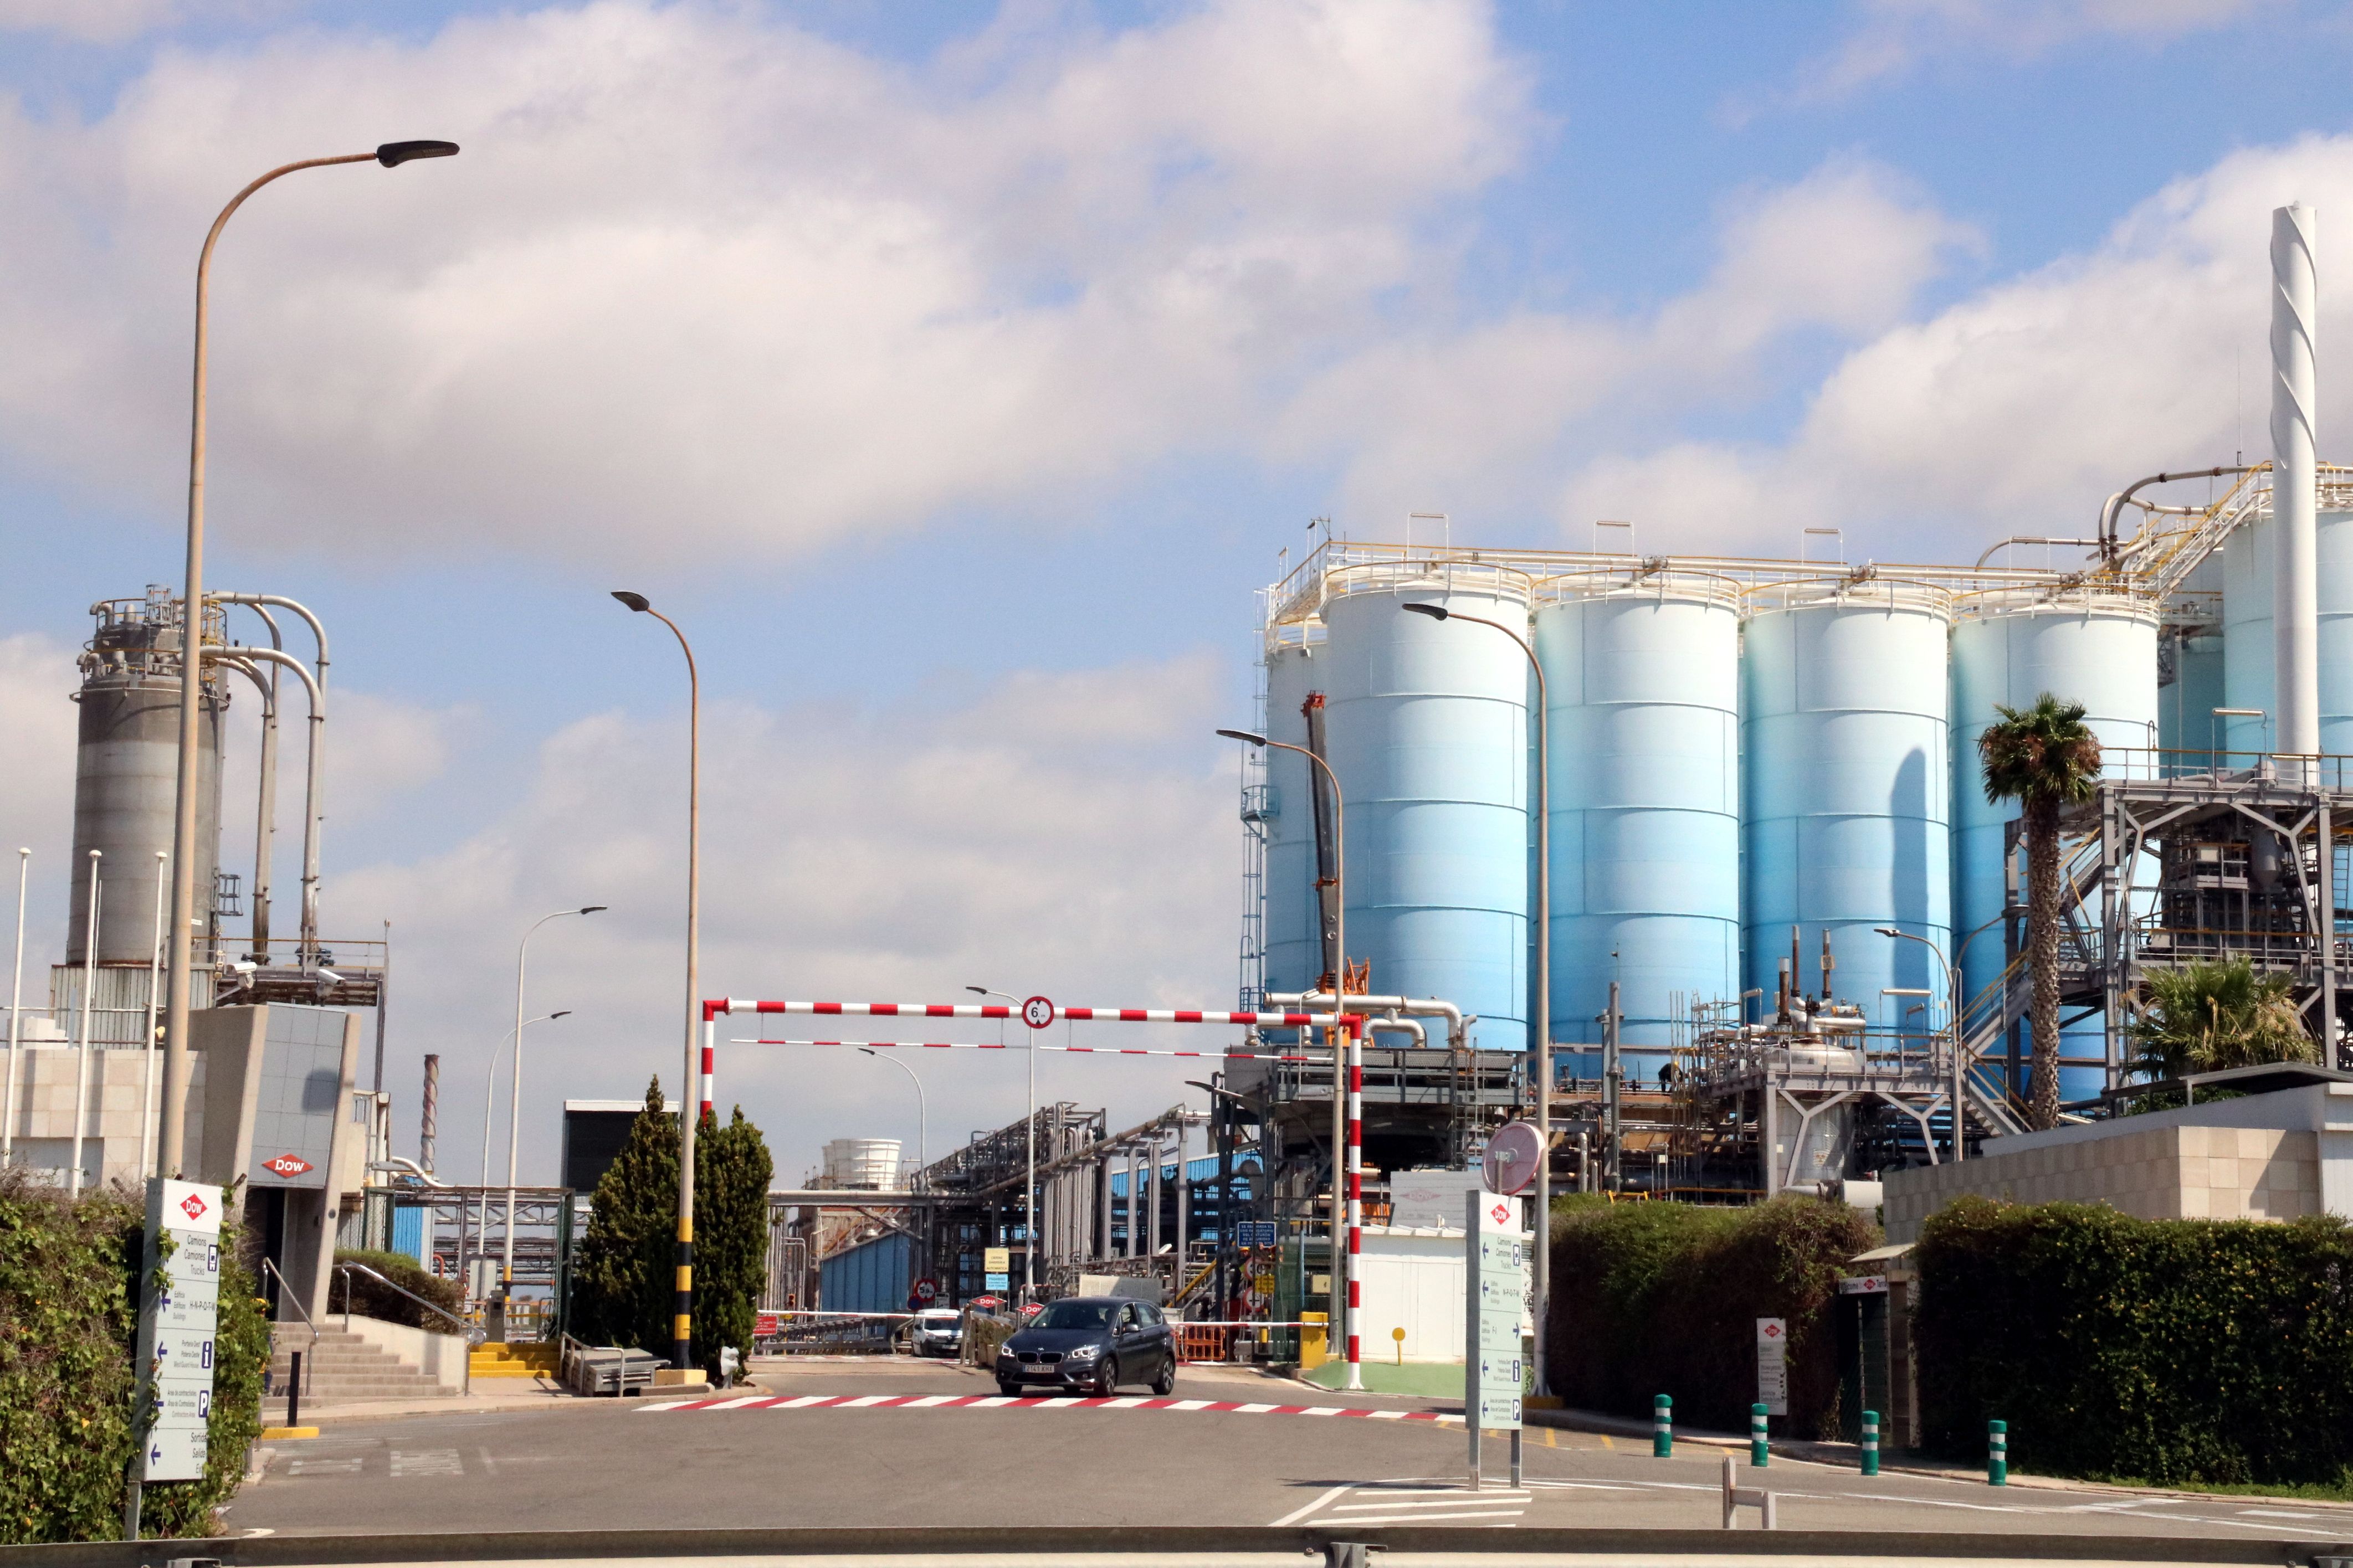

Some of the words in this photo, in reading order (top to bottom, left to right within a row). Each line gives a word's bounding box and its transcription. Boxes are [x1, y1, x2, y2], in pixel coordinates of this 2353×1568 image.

[275, 1159, 304, 1171] Dow
[186, 1200, 202, 1214] Dow
[187, 1235, 207, 1247] Camions
[184, 1249, 206, 1261] Camiones
[191, 1264, 204, 1276] Trucks
